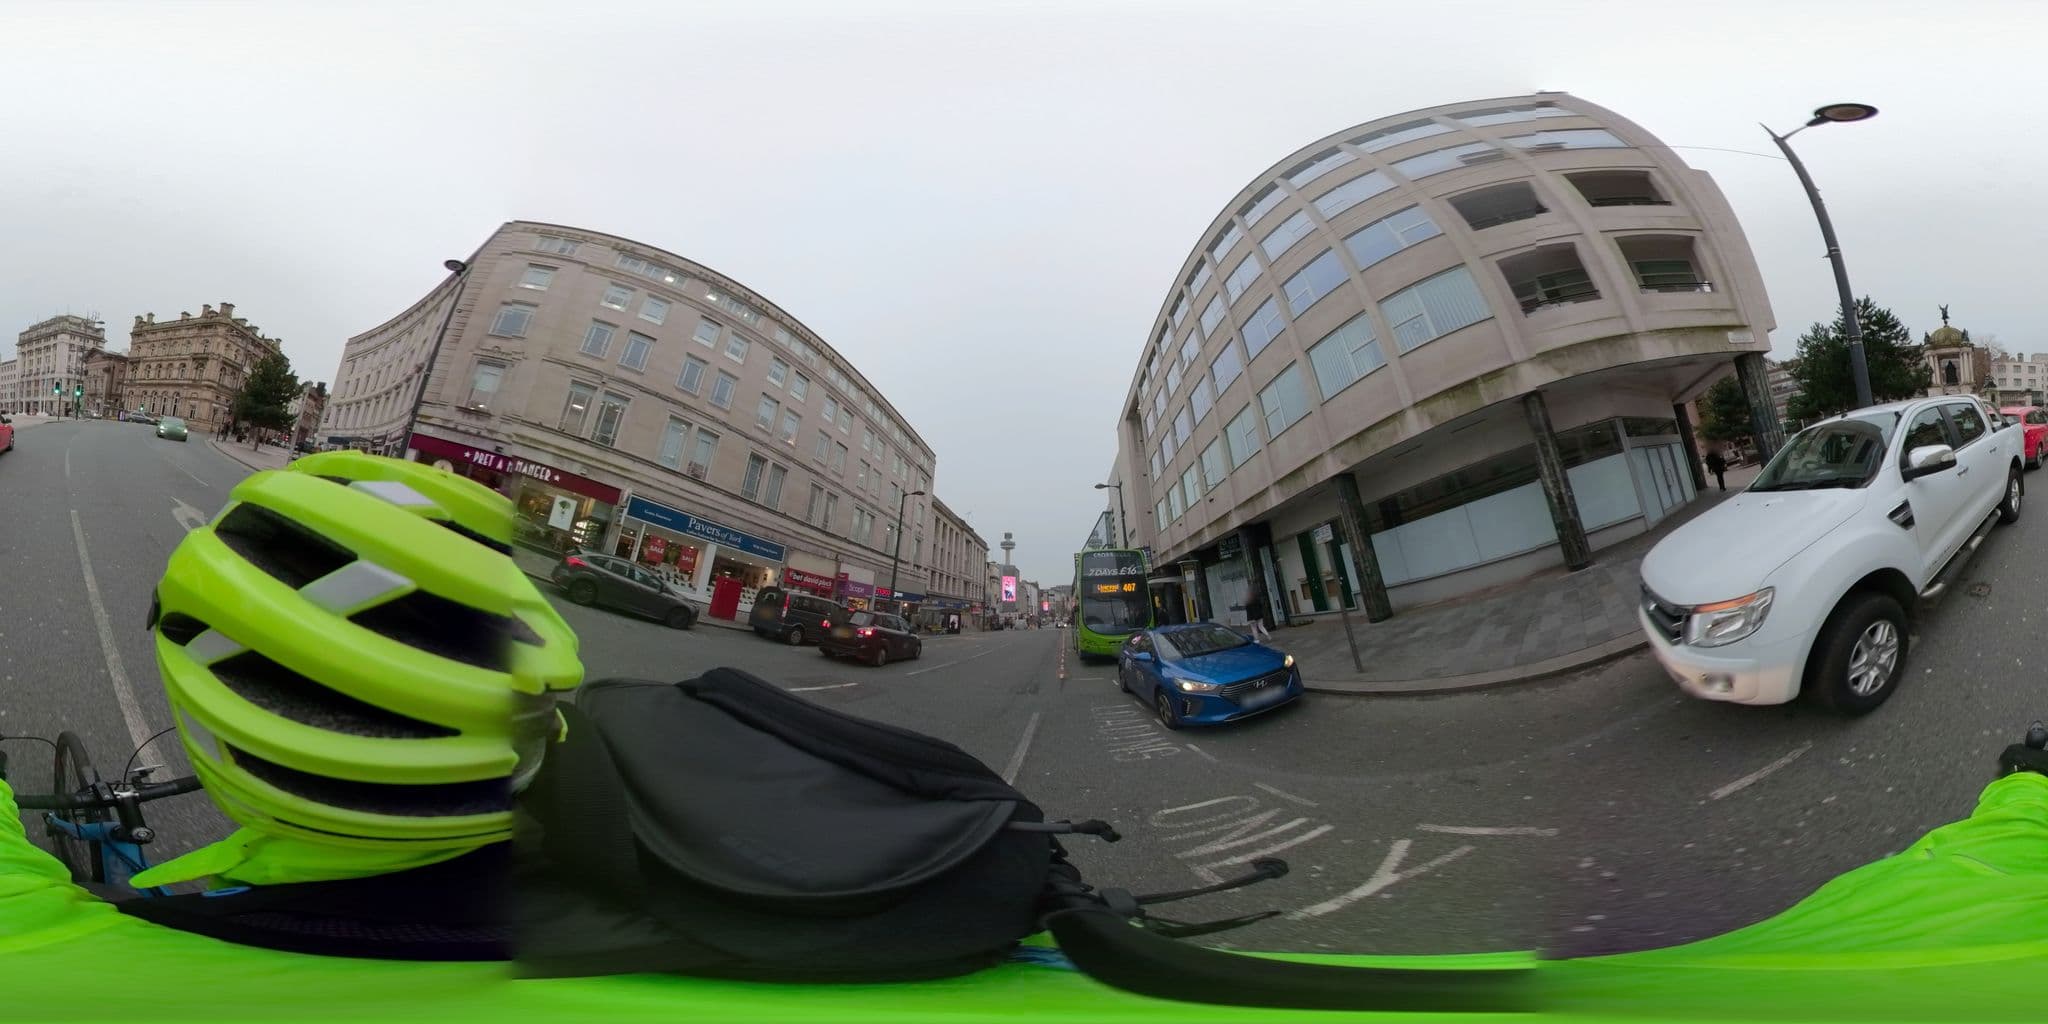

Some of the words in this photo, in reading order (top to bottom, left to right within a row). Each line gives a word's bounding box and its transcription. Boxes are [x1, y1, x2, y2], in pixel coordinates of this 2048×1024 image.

[473, 451, 496, 467] PRET
[496, 459, 504, 470] A
[688, 517, 721, 537] Pavers
[650, 545, 665, 554] SALE
[1094, 567, 1118, 577] DAYS
[1118, 564, 1137, 576] £16
[1122, 583, 1136, 593] 407
[1149, 796, 1475, 921] ONLY
